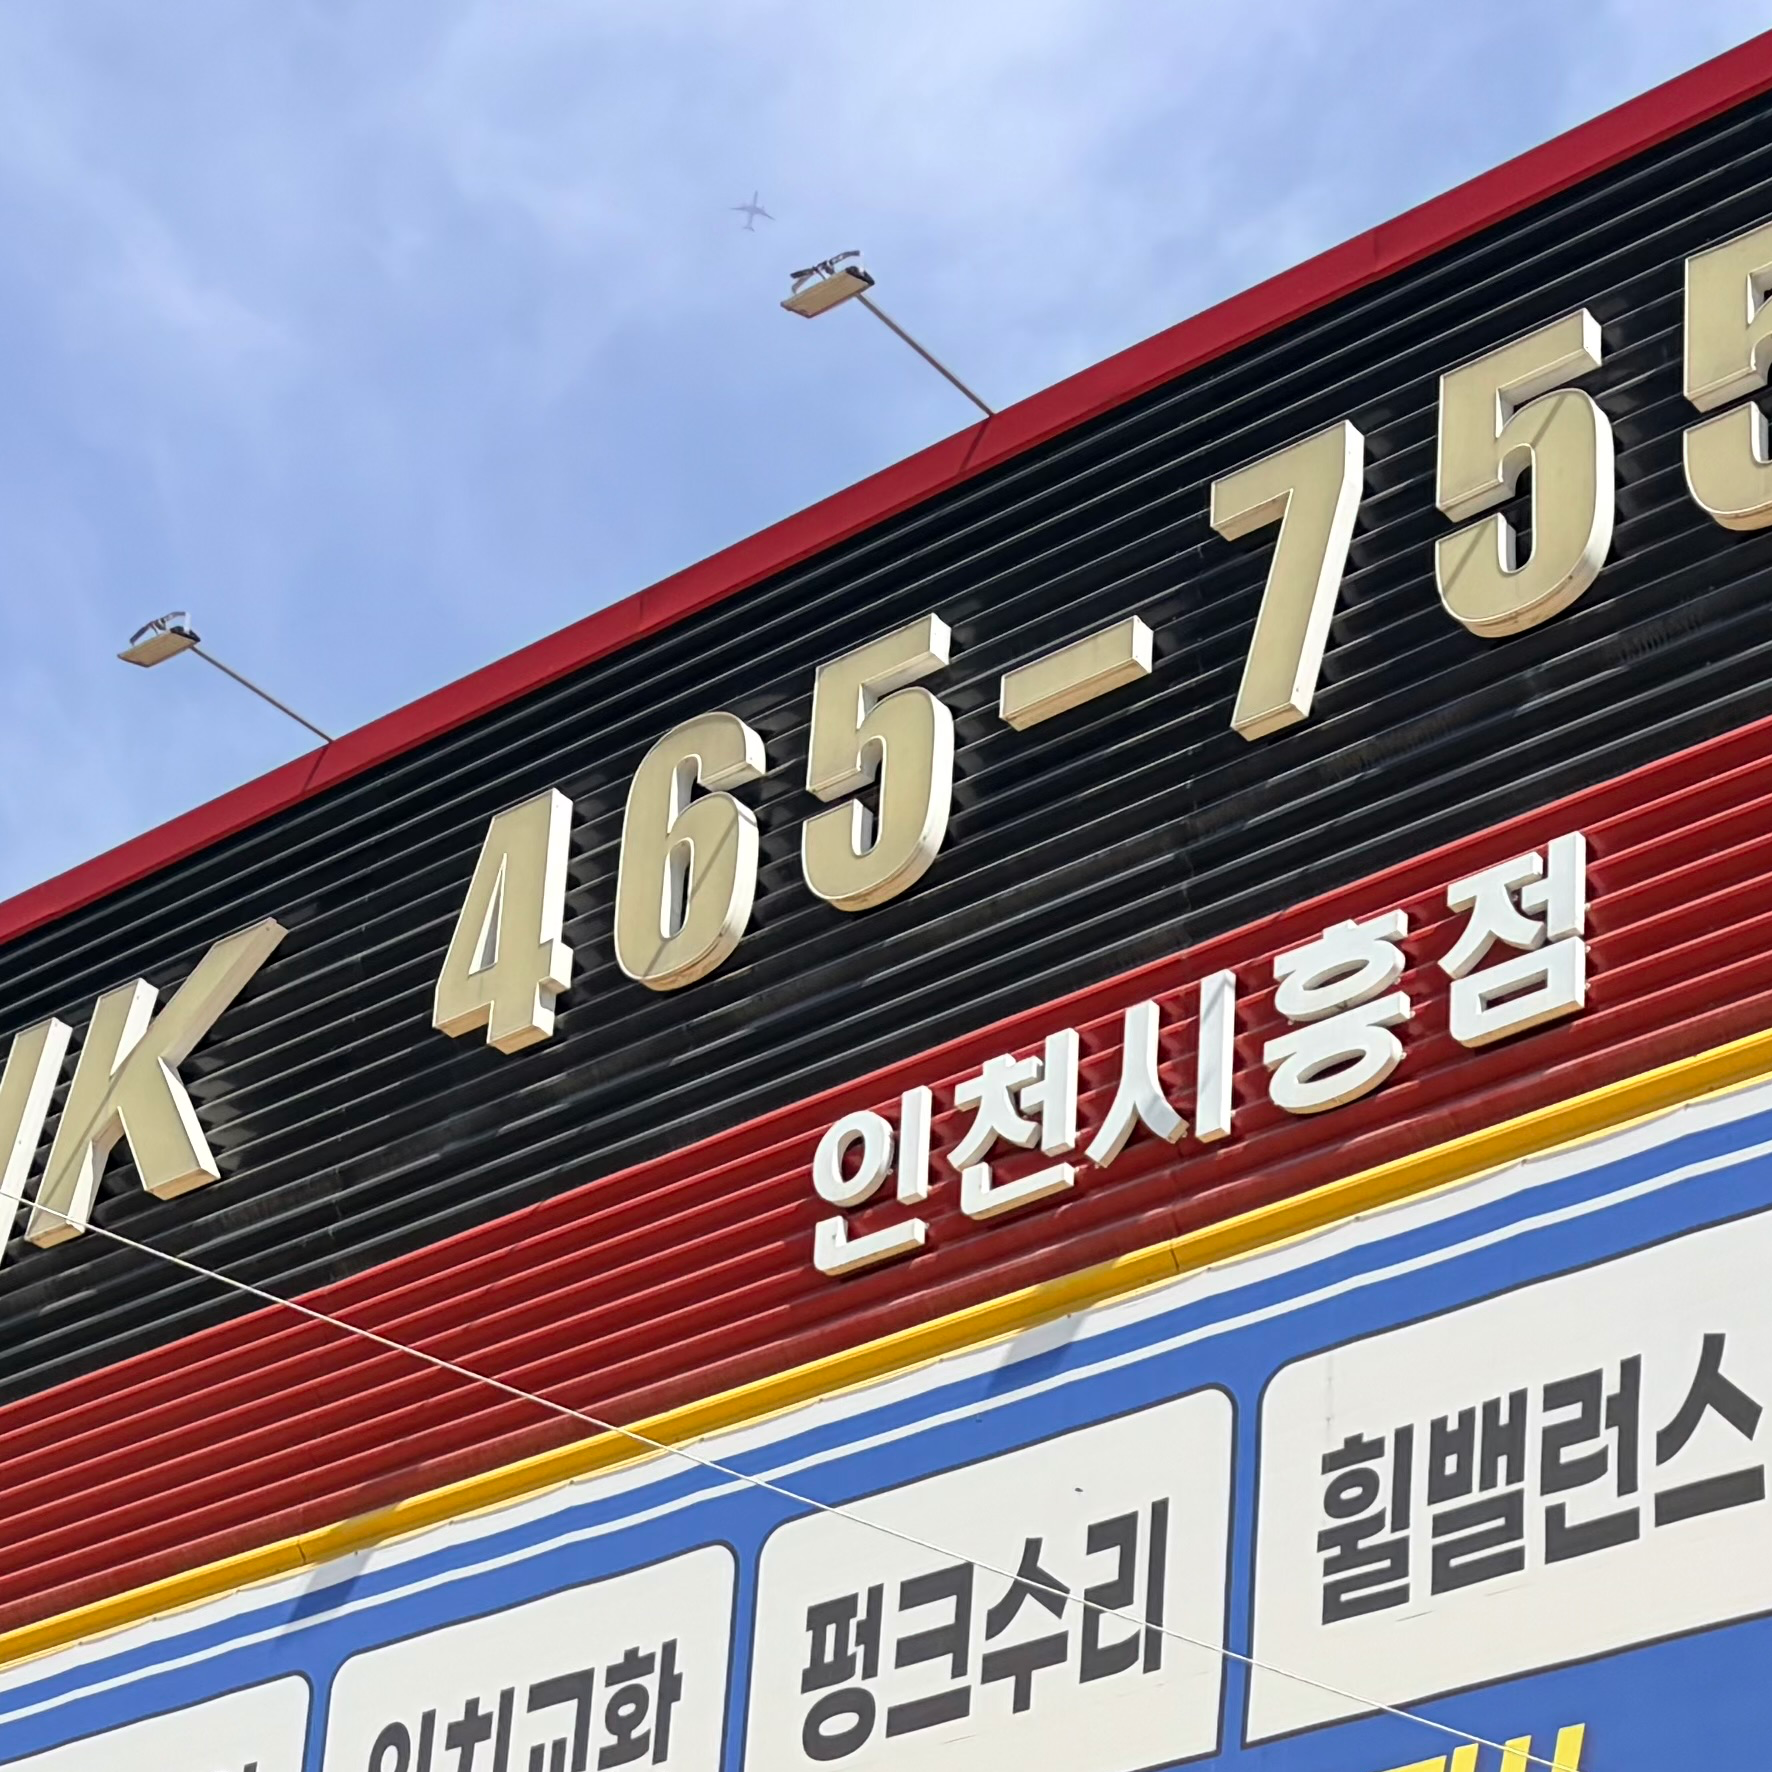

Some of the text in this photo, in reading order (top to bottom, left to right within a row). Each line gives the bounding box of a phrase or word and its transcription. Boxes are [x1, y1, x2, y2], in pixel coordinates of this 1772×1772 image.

[812, 831, 1590, 1277] 인천시흥점
[1315, 1331, 1766, 1625] 휠밸런스
[800, 1497, 1168, 1763] 펑크수리
